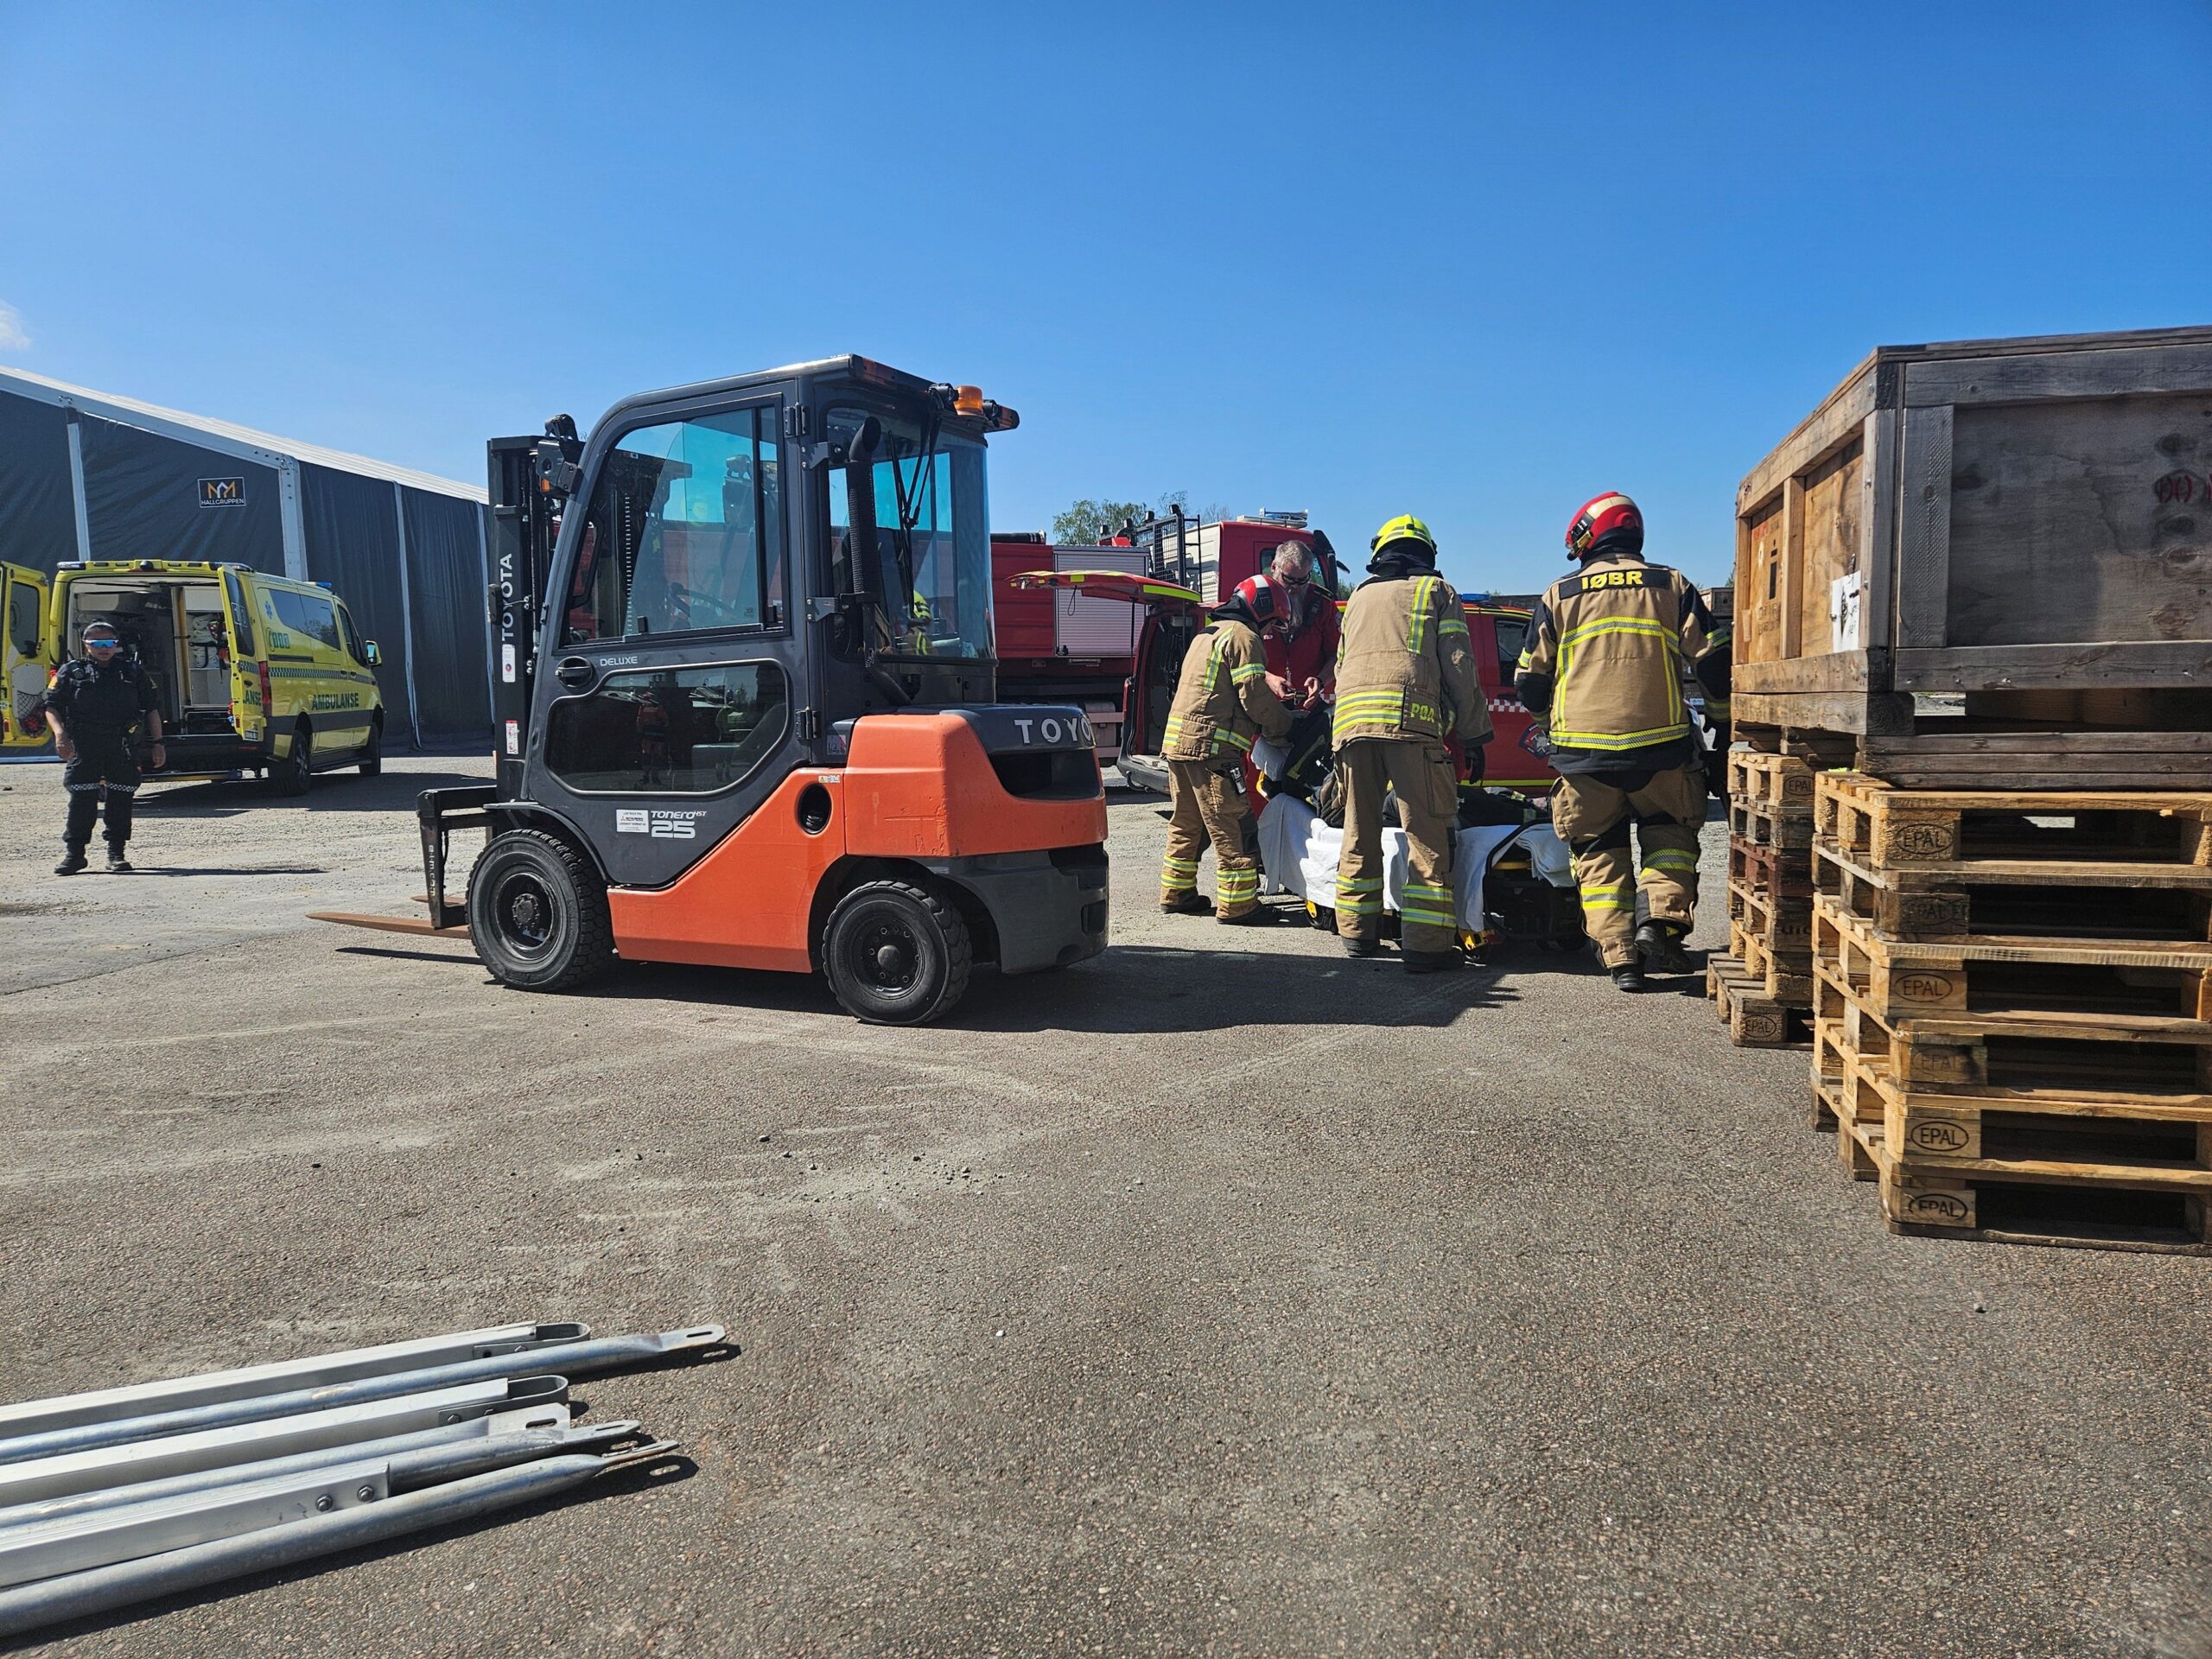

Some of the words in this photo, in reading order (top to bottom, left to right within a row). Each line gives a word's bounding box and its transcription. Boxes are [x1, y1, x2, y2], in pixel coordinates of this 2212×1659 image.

[1581, 570, 1643, 590] IØBR
[499, 552, 514, 642] TOYOTA
[600, 656, 639, 666] DELUXE
[311, 692, 359, 710] AMBULANSE
[651, 819, 696, 839] 25
[1904, 830, 1946, 848] EPAL
[1903, 980, 1943, 996] EPAL
[1745, 1019, 1772, 1033] EPAL
[1920, 1127, 1961, 1146] EPAL
